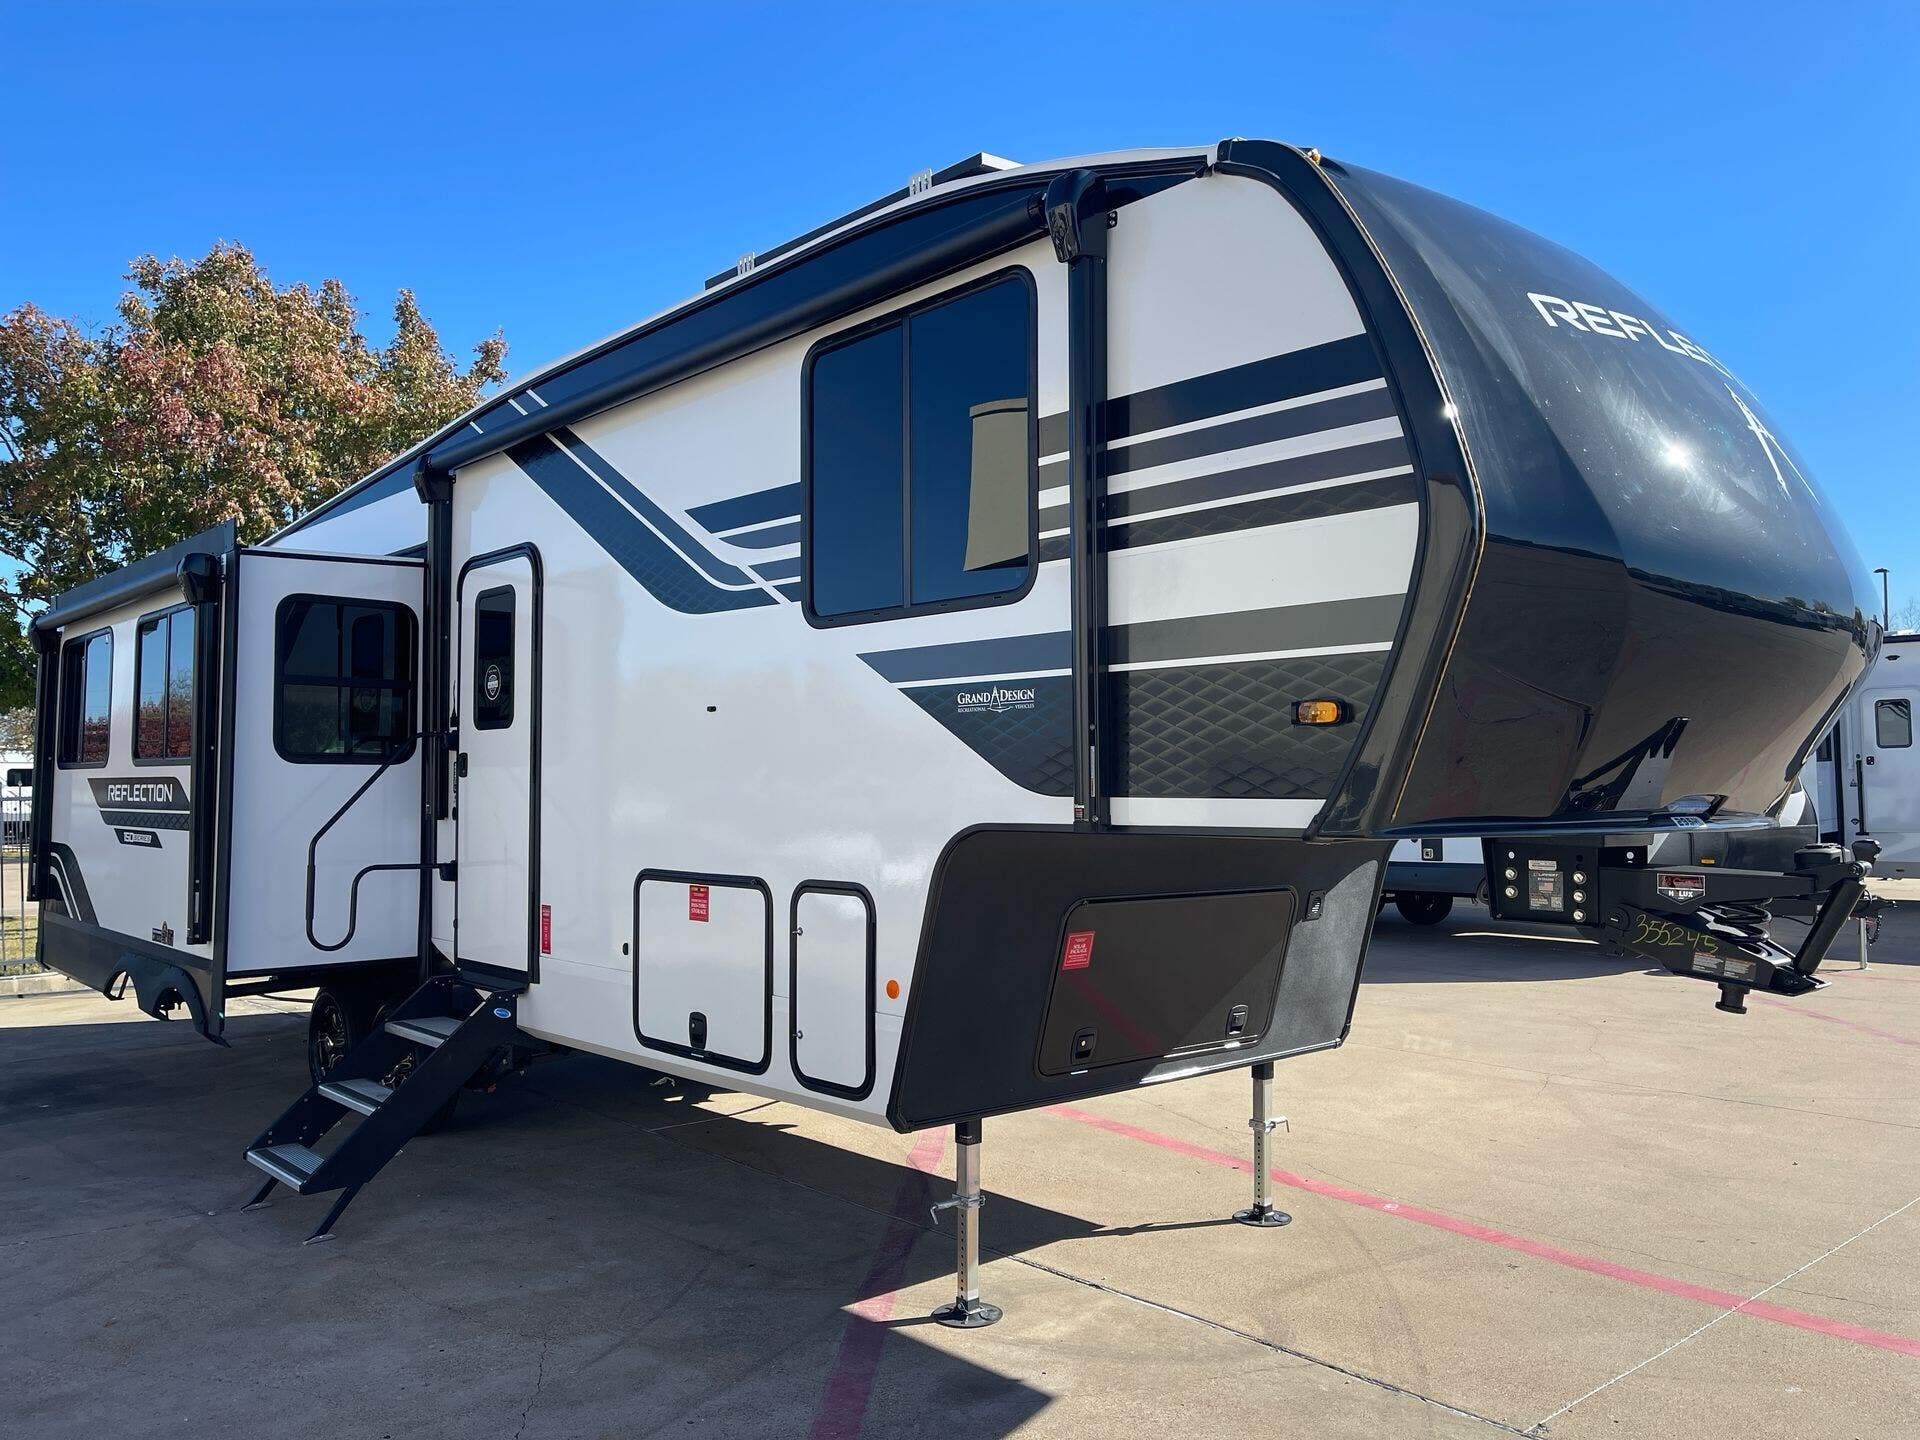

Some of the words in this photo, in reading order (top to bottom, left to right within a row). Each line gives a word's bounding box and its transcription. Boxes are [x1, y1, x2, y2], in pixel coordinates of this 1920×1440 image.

[957, 692, 991, 705] GRAND
[1000, 688, 1035, 702] DESIGN
[107, 784, 173, 802] REFLECTION
[1632, 913, 1719, 954] 355245
